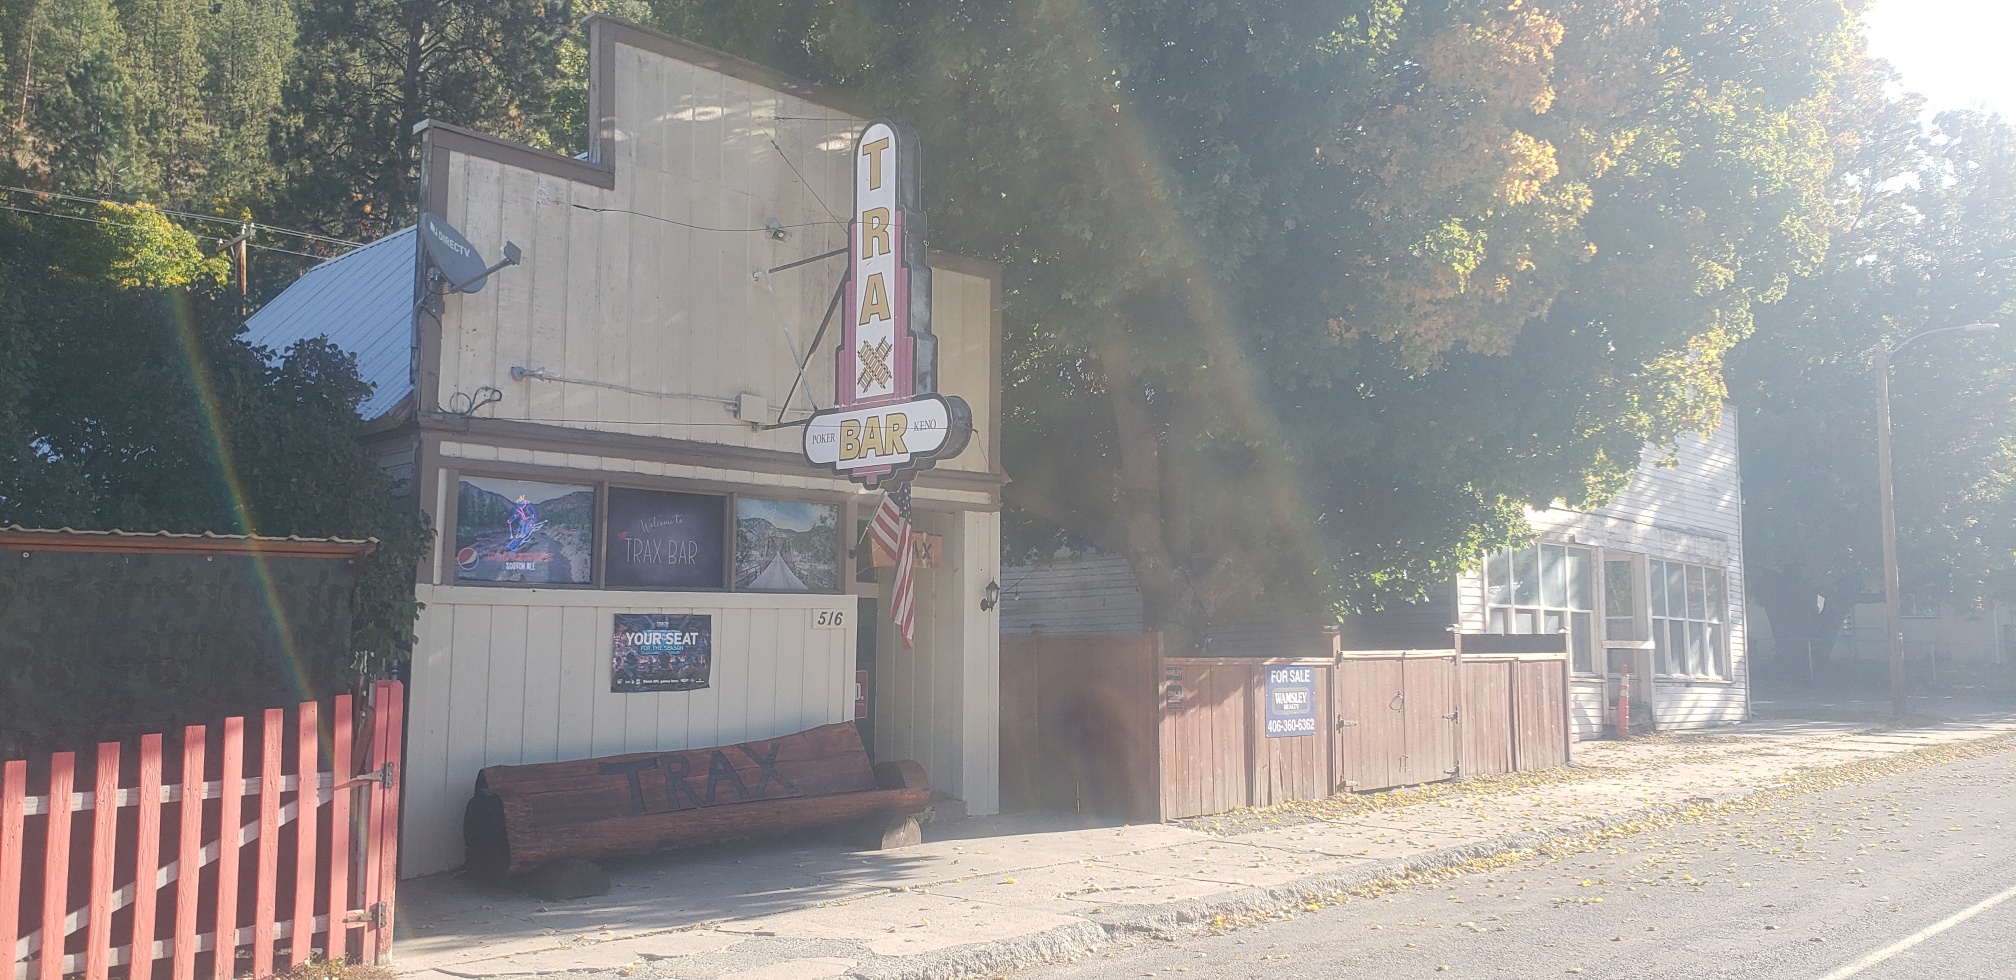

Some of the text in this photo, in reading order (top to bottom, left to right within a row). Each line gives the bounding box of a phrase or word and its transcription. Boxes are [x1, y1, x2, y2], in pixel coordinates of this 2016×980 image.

[438, 230, 470, 258] DIRECTV
[857, 137, 893, 393] TRAX
[812, 413, 937, 461] POKER BAR KENO
[641, 513, 684, 532] Welcome to
[625, 538, 698, 565] TRAX BAR
[911, 540, 931, 560] AX
[505, 562, 535, 570] SCOTCH ALE
[818, 611, 844, 626] 516
[626, 632, 699, 645] YOUR SEAT
[1271, 669, 1311, 683] FOR SALE
[1274, 692, 1307, 704] WAMSLEY
[1268, 718, 1315, 732] 406-360-6362
[599, 743, 800, 815] TRAX
